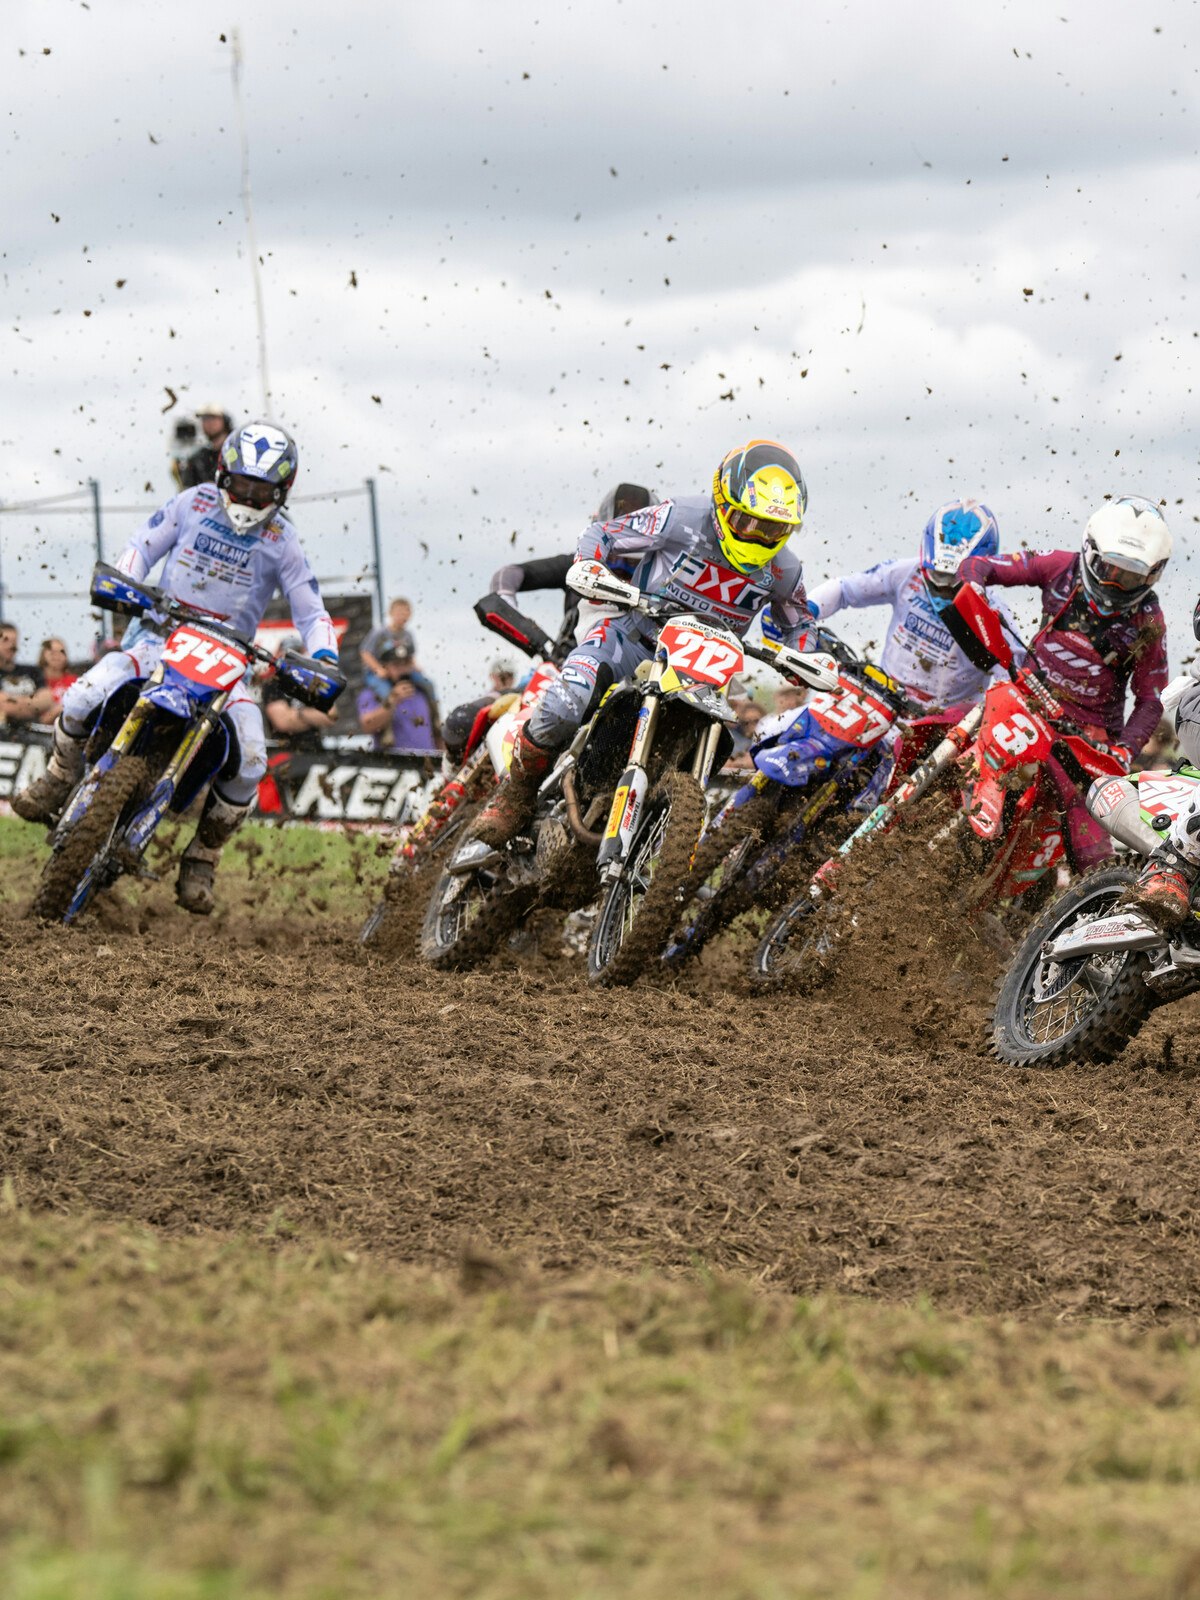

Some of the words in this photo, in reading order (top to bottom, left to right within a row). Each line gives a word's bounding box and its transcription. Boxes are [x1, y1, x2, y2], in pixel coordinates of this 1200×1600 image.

[667, 584, 710, 612] MOTO
[160, 632, 246, 687] 347
[668, 631, 740, 684] 212
[991, 712, 1039, 756] 3
[1032, 833, 1062, 868] 3
